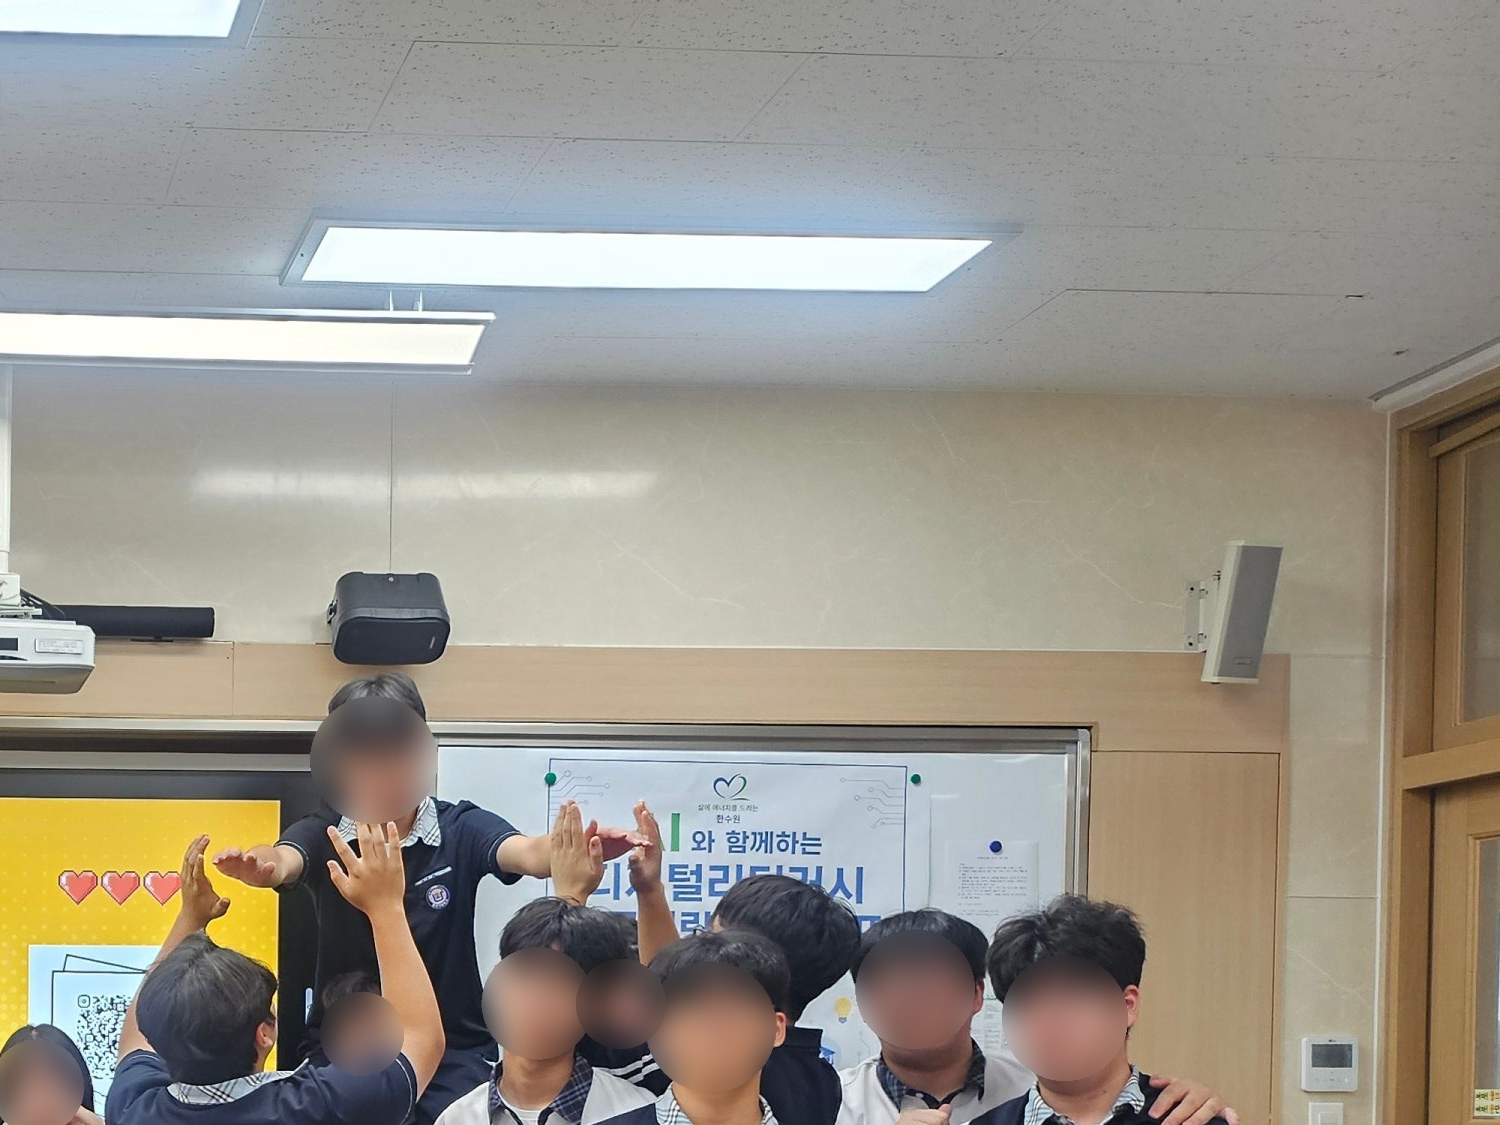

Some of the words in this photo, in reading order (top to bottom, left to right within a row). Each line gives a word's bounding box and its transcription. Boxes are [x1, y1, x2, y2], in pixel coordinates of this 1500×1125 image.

[716, 815, 741, 824] 한수원
[691, 830, 715, 853] 와
[725, 830, 823, 855] 함께하는
